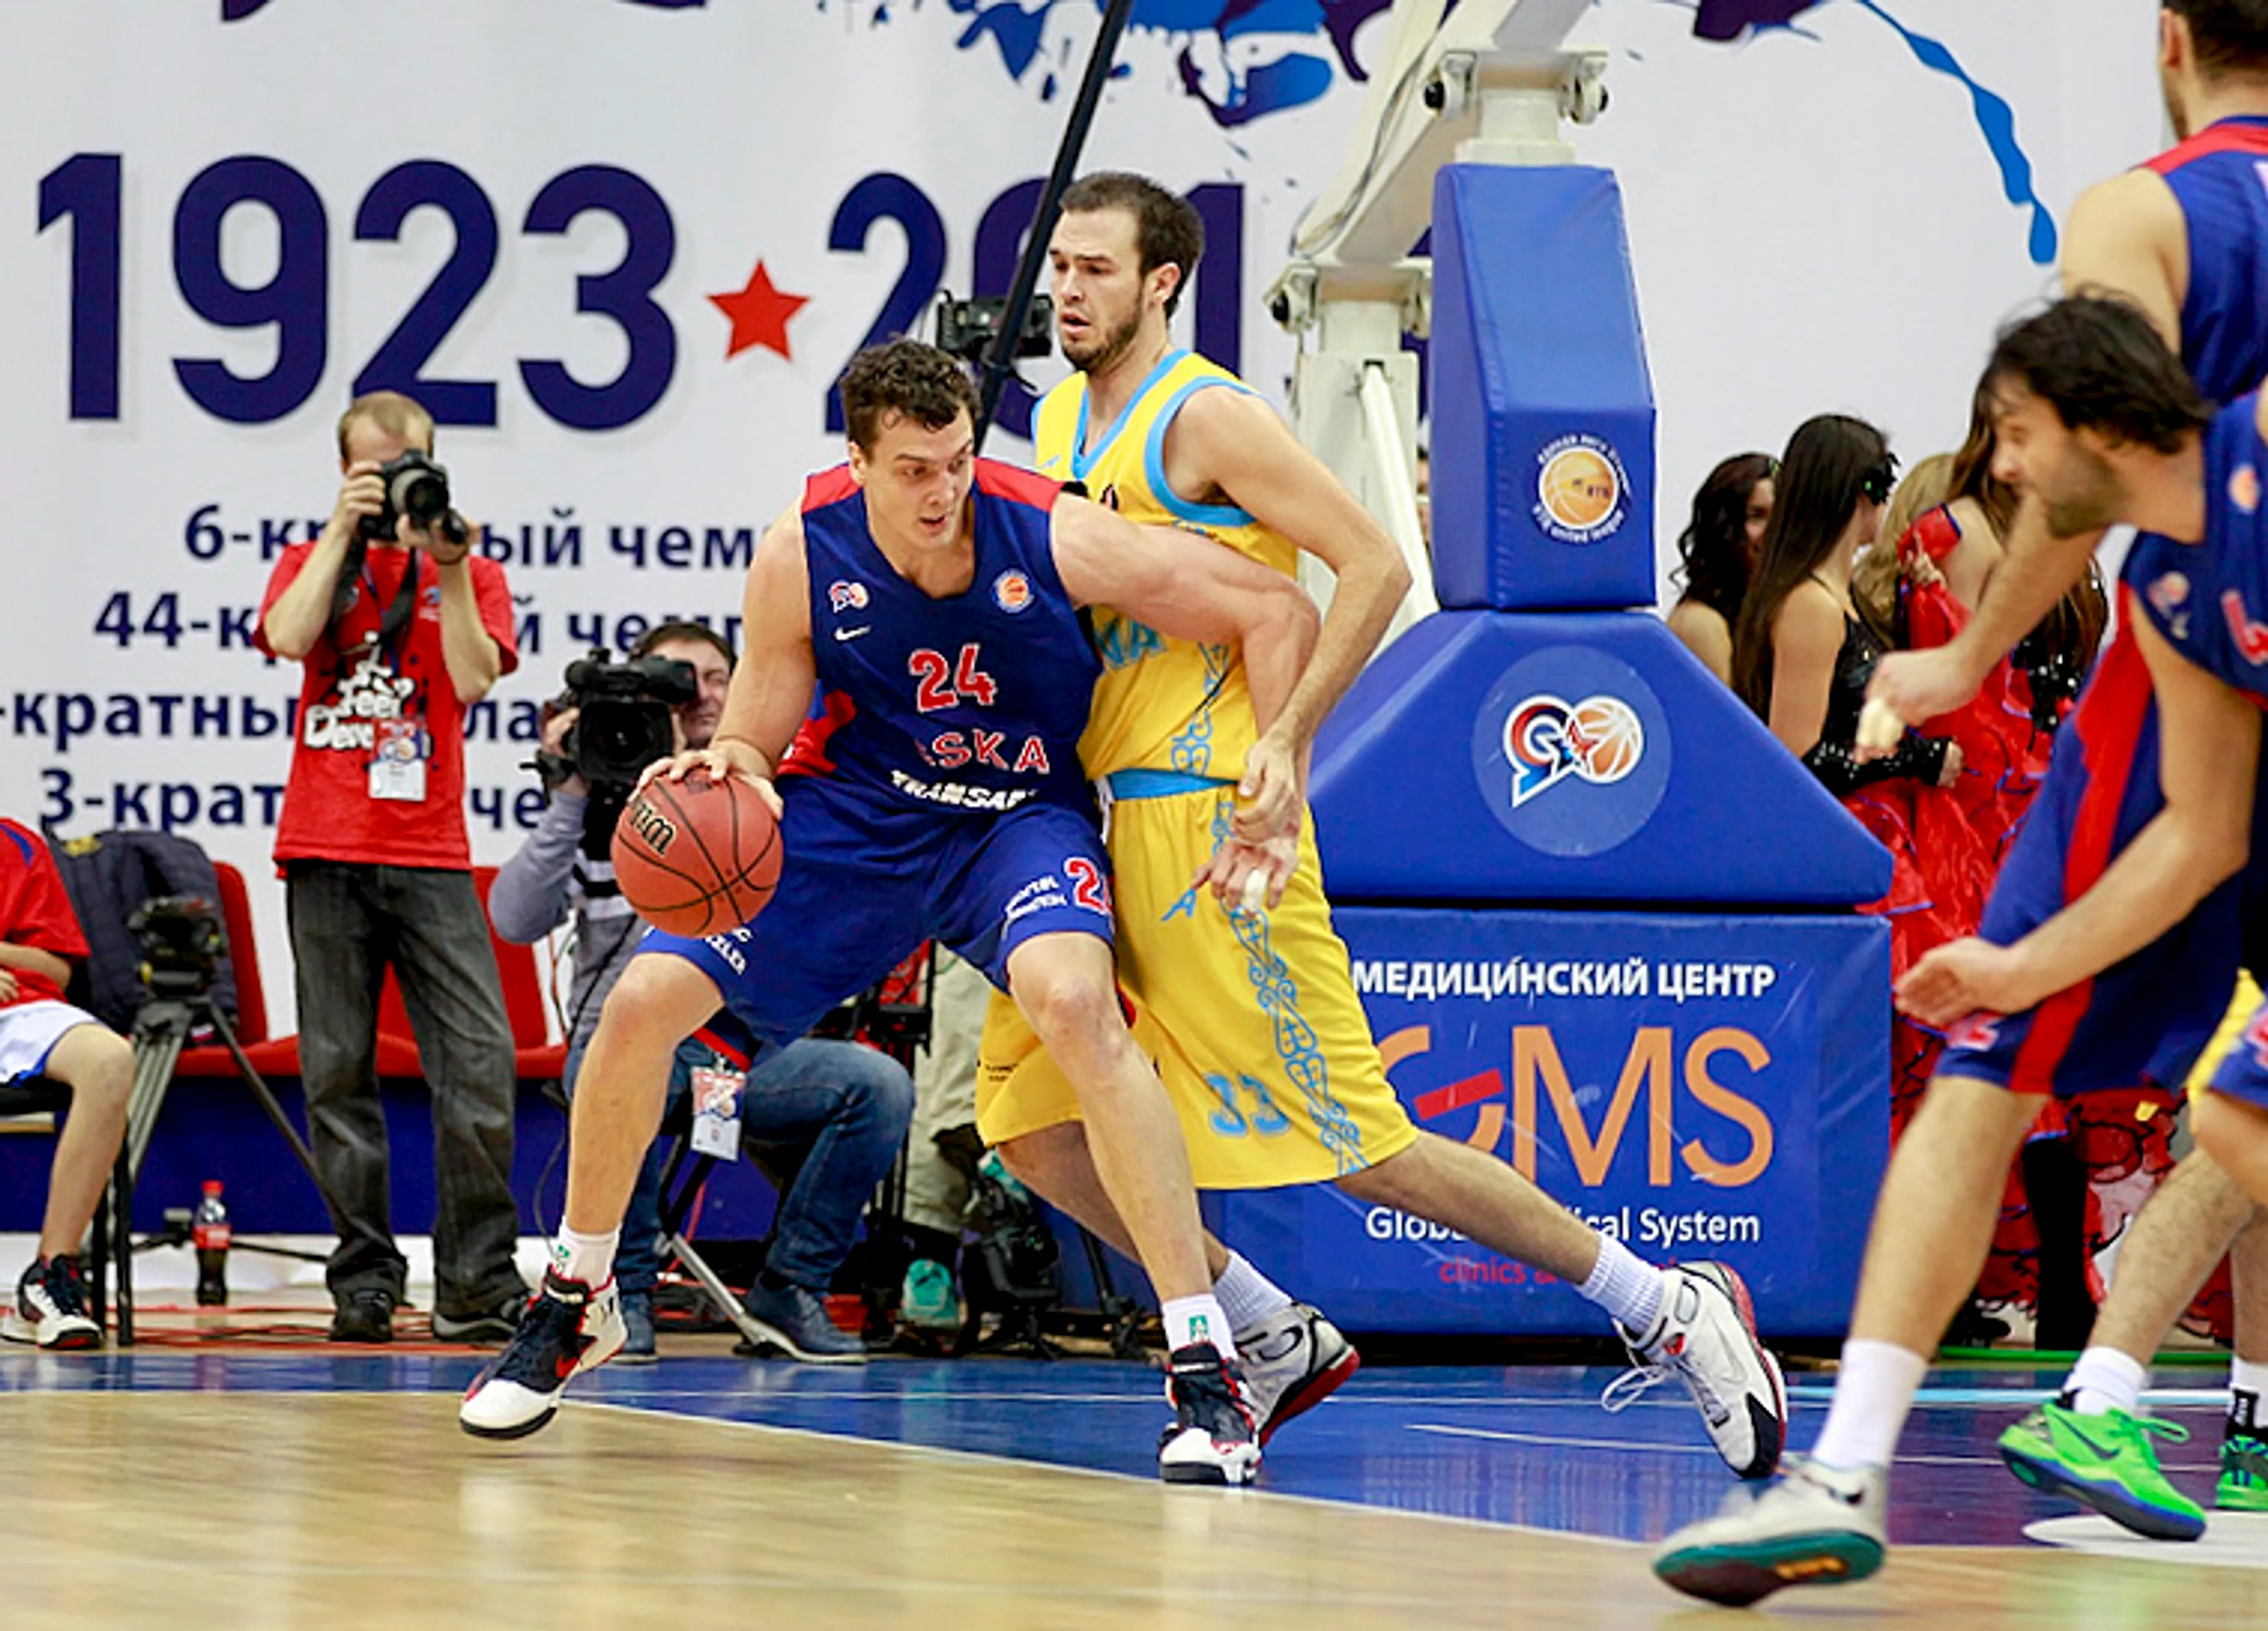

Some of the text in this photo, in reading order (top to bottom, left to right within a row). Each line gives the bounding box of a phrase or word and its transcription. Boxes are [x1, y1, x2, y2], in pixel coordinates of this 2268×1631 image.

[37, 152, 679, 432] 1923
[908, 642, 998, 712] 24
[1063, 856, 1113, 915] 2
[1658, 962, 1776, 1004] ЦЕНТР
[1203, 1072, 1292, 1139] 33
[1639, 1206, 1761, 1249] System
[1439, 1255, 1527, 1284] clinics
